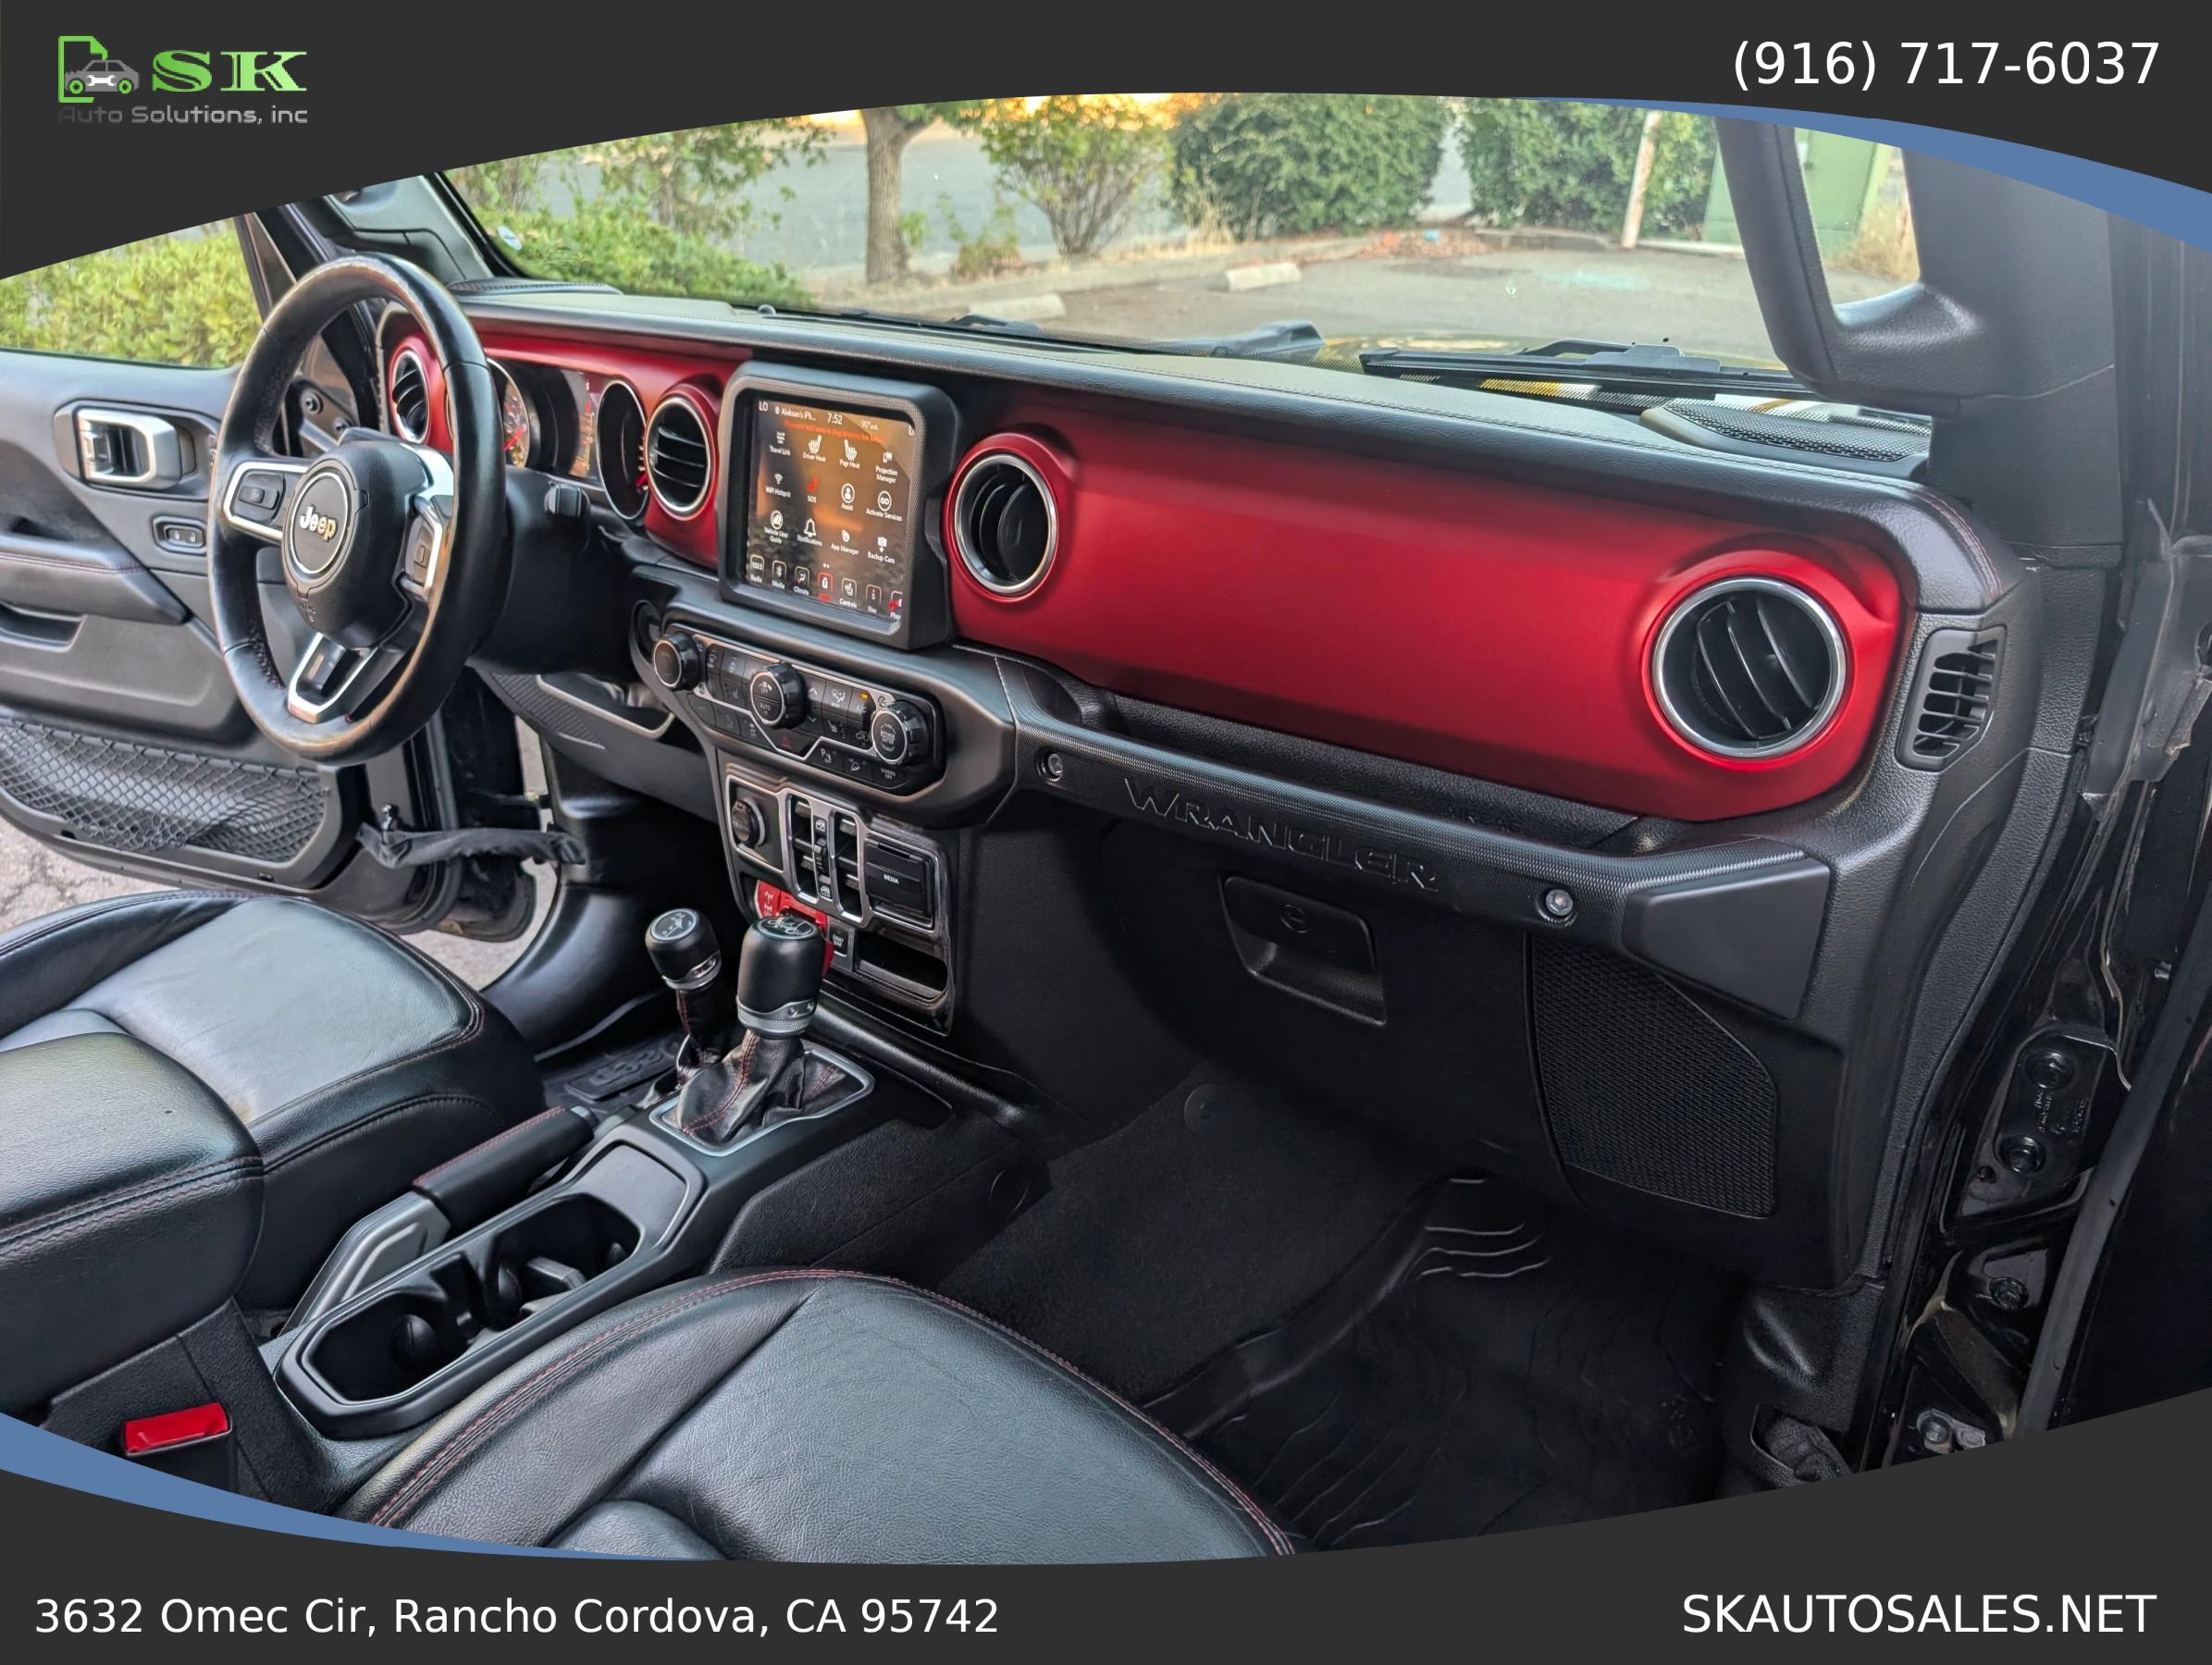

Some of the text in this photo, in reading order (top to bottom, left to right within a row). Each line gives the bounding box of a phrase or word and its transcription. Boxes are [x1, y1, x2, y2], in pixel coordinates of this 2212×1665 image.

[759, 401, 769, 411] LO
[827, 413, 843, 425] 7:52
[876, 465, 897, 475] Projection
[876, 474, 896, 484] Manager
[866, 508, 902, 522] Activate Services
[300, 507, 339, 542] Jeep
[841, 546, 859, 555] Manager
[868, 551, 895, 564] Backup Cam
[839, 598, 857, 609] Controls
[760, 703, 772, 711] AUTO
[1125, 778, 1439, 892] WRANGLER
[884, 873, 898, 884] MEDIA
